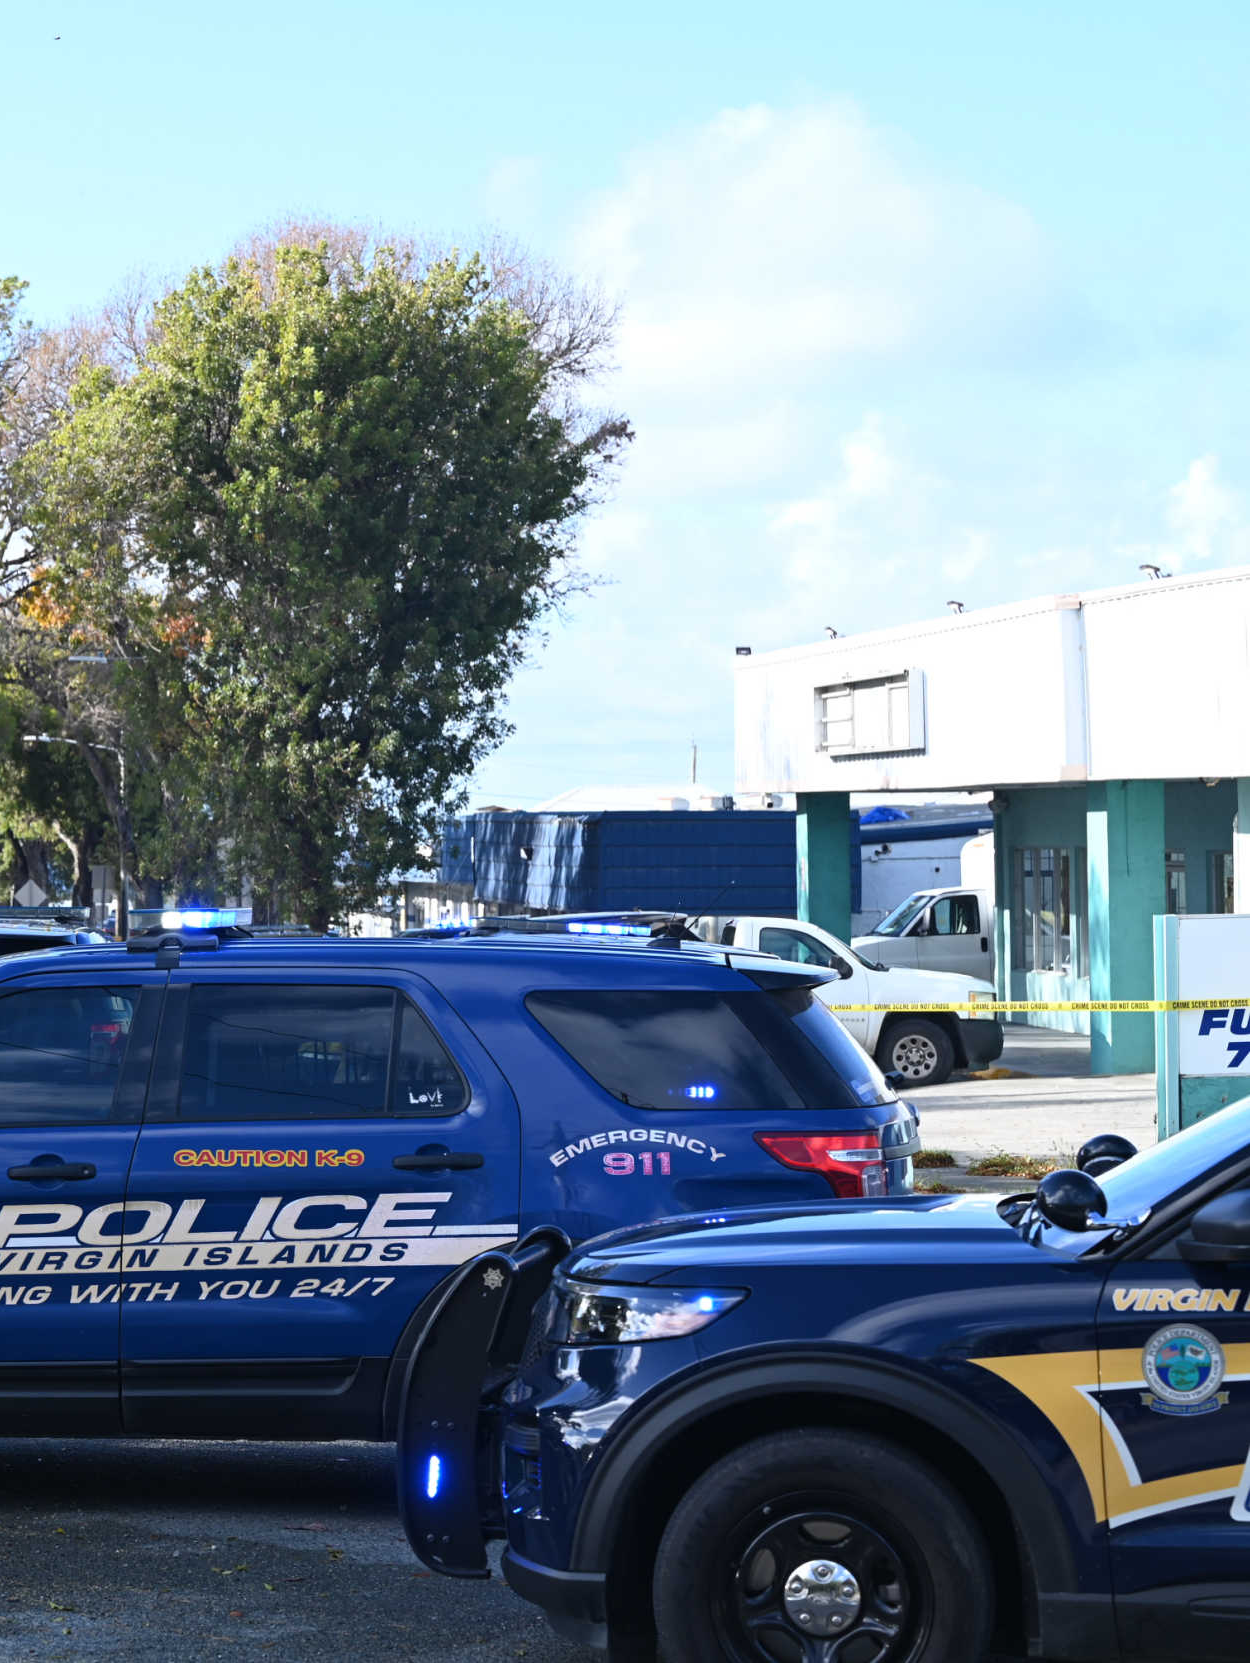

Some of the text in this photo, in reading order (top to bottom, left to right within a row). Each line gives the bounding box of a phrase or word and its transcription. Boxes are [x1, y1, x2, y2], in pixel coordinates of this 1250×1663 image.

[1231, 999, 1248, 1007] CROSS
[174, 1149, 365, 1167] CAUTION K-9
[549, 1128, 726, 1168] EMERGENCY
[603, 1151, 671, 1176] 911
[184, 1242, 410, 1267] ISLANDS
[70, 1281, 180, 1304] WITH
[198, 1278, 281, 1301] YOU
[290, 1277, 395, 1299] 24/7
[1112, 1288, 1242, 1312] VIRGIN
